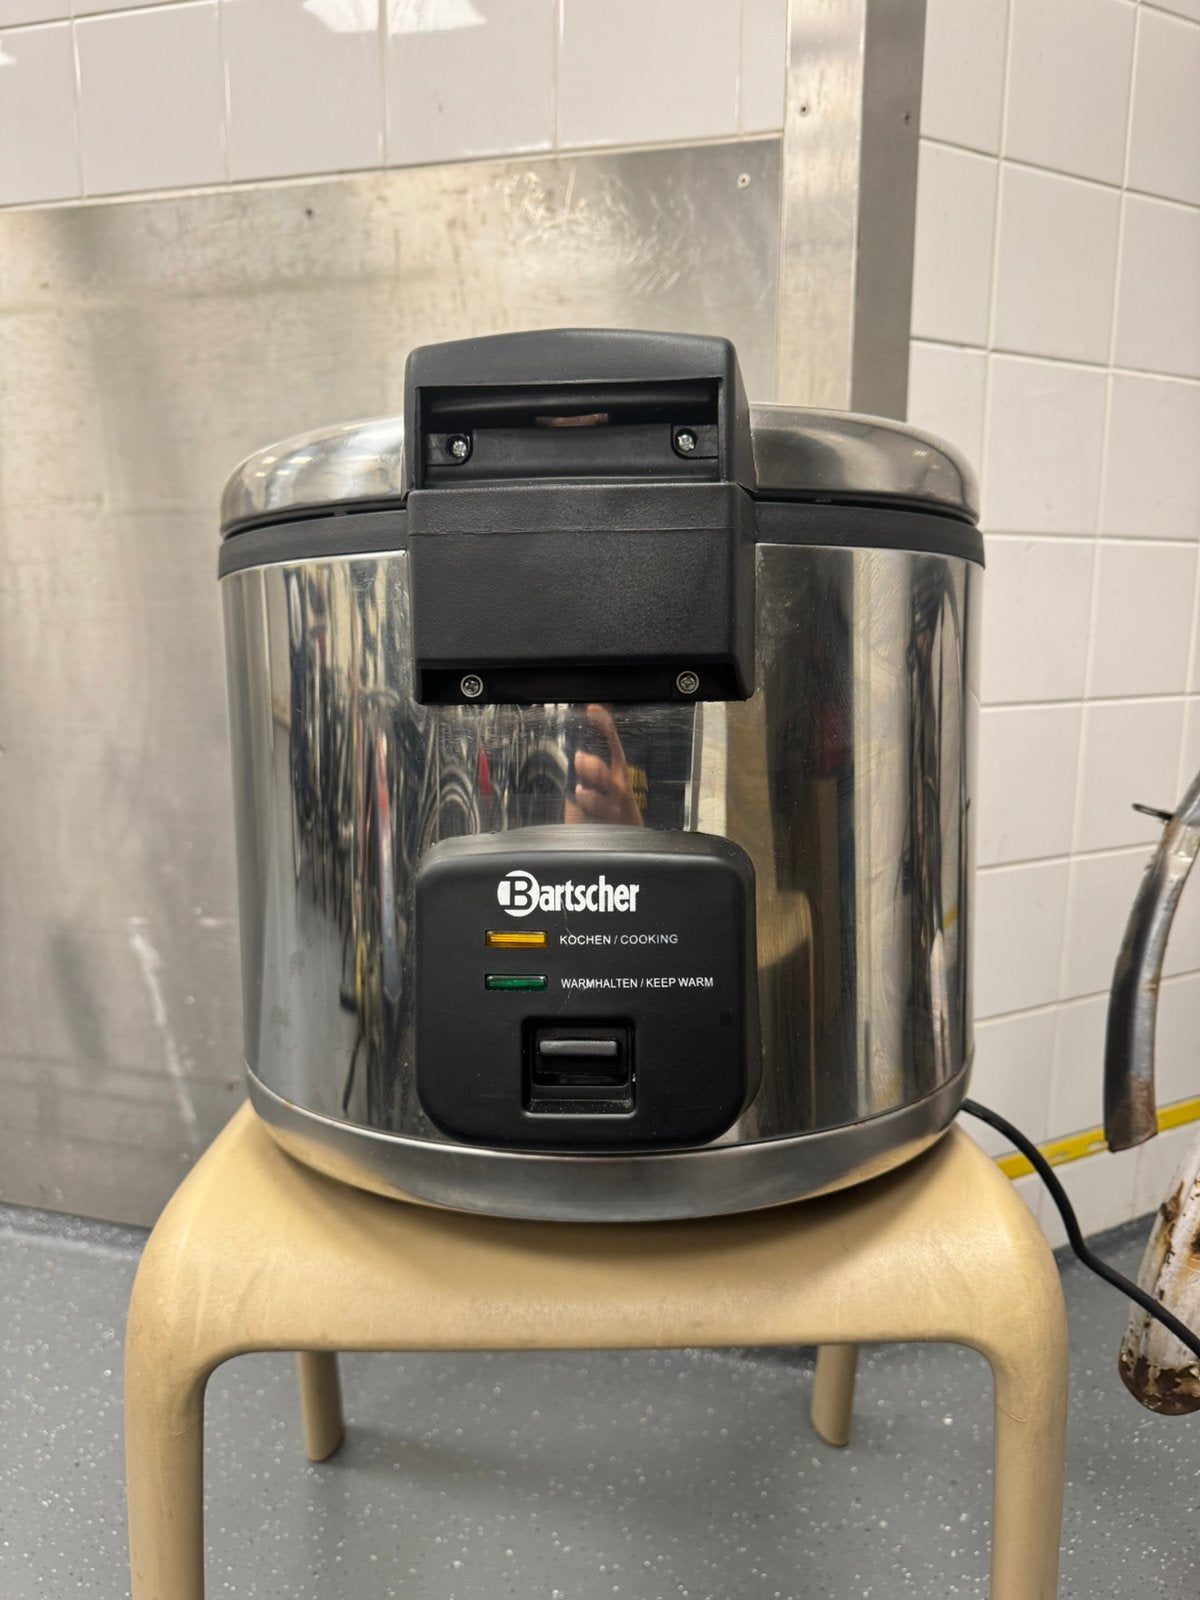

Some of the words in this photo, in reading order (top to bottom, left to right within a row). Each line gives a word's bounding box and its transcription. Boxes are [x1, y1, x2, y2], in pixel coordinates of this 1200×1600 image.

[497, 870, 640, 917] Bartscher
[559, 935, 611, 945] KOCHEN
[620, 934, 679, 945] COOKING
[560, 978, 638, 989] WARMHALTEN
[646, 977, 676, 988] KEEP
[678, 977, 714, 988] WARM
